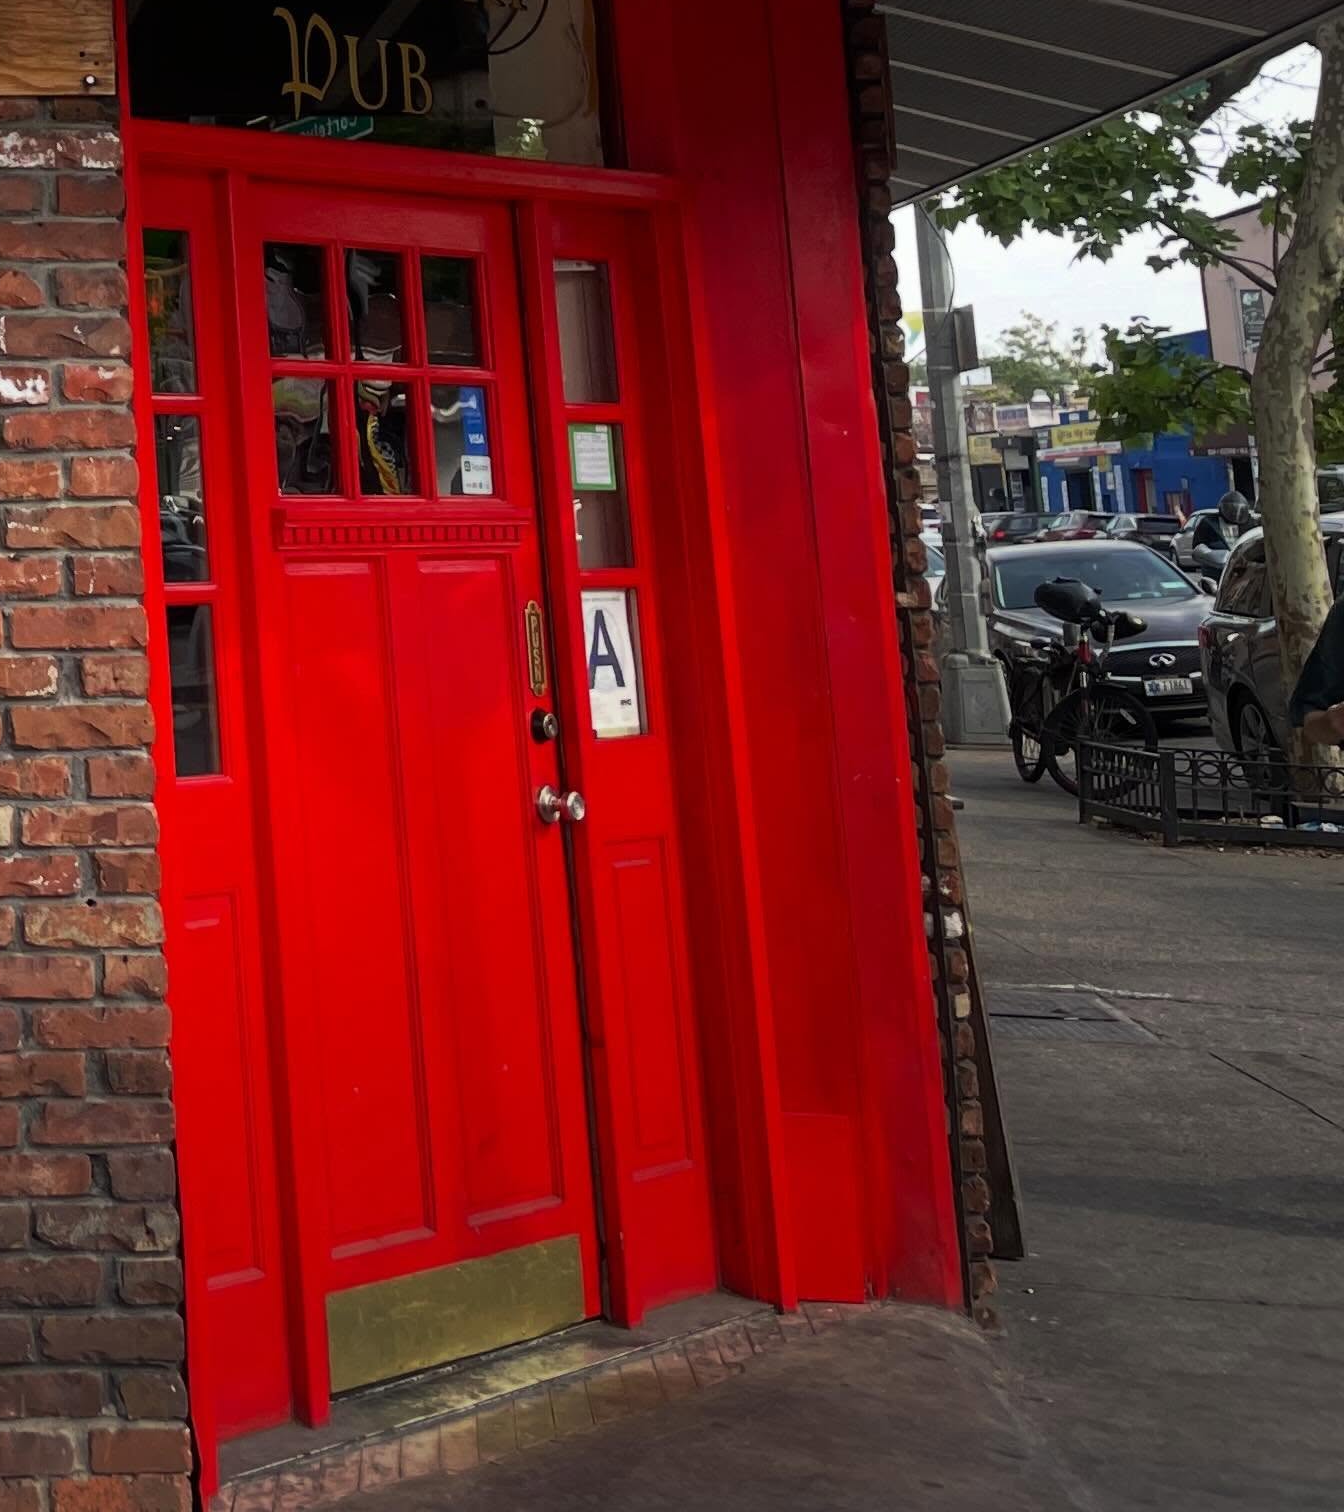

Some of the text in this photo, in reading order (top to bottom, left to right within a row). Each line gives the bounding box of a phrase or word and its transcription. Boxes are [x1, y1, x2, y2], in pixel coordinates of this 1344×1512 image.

[272, 6, 435, 119] PUB
[530, 616, 543, 683] PUSH
[589, 609, 626, 690] A
